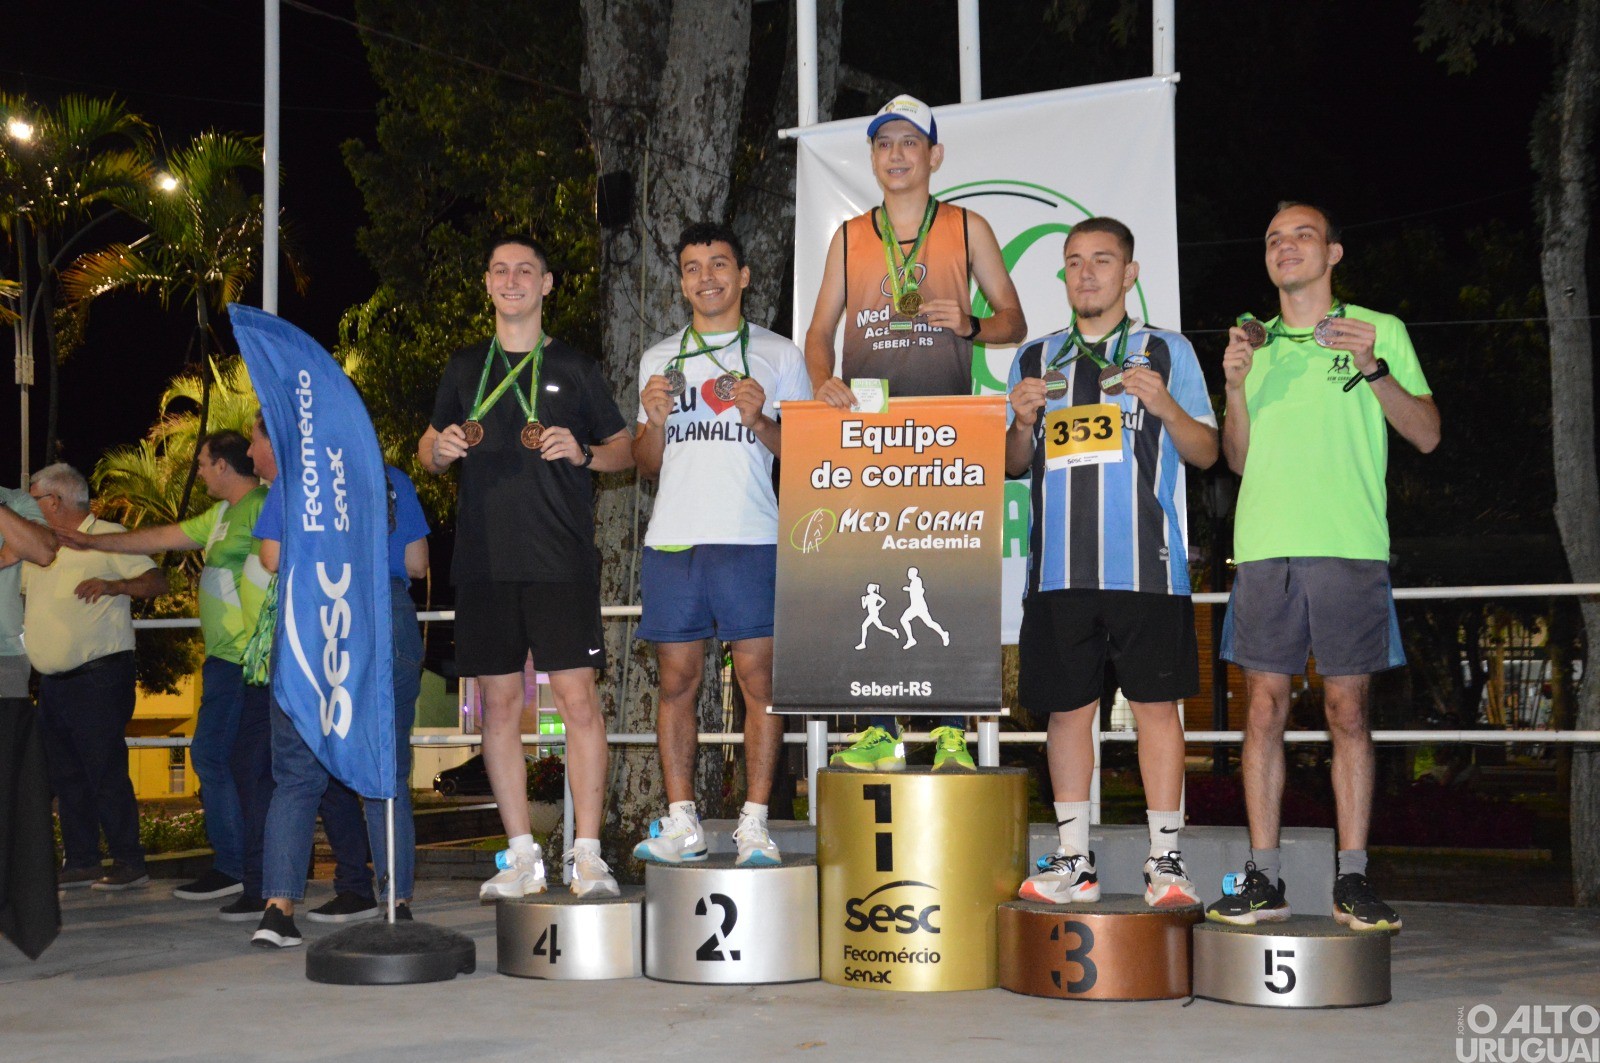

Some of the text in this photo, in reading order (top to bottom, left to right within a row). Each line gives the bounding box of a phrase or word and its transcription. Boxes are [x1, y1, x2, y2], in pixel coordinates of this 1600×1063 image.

[857, 304, 890, 327] Med
[865, 323, 943, 339] Acamia
[873, 338, 910, 350] SEBERI
[919, 336, 933, 346] RS
[667, 421, 756, 444] PLANALTO
[841, 419, 957, 453] Equipe
[1053, 415, 1113, 446] 353
[296, 369, 325, 532] Fecomércio
[810, 457, 985, 489] de corrida
[326, 447, 350, 532] Senac
[881, 534, 982, 550] Academia
[850, 681, 933, 697] Seberi-RS
[863, 784, 893, 872] 1
[695, 893, 741, 961] 2
[532, 923, 562, 964] 4
[843, 945, 941, 964] Fecomércio
[1050, 920, 1098, 994] 3
[844, 966, 892, 984] Senac
[1264, 949, 1297, 995] 5
